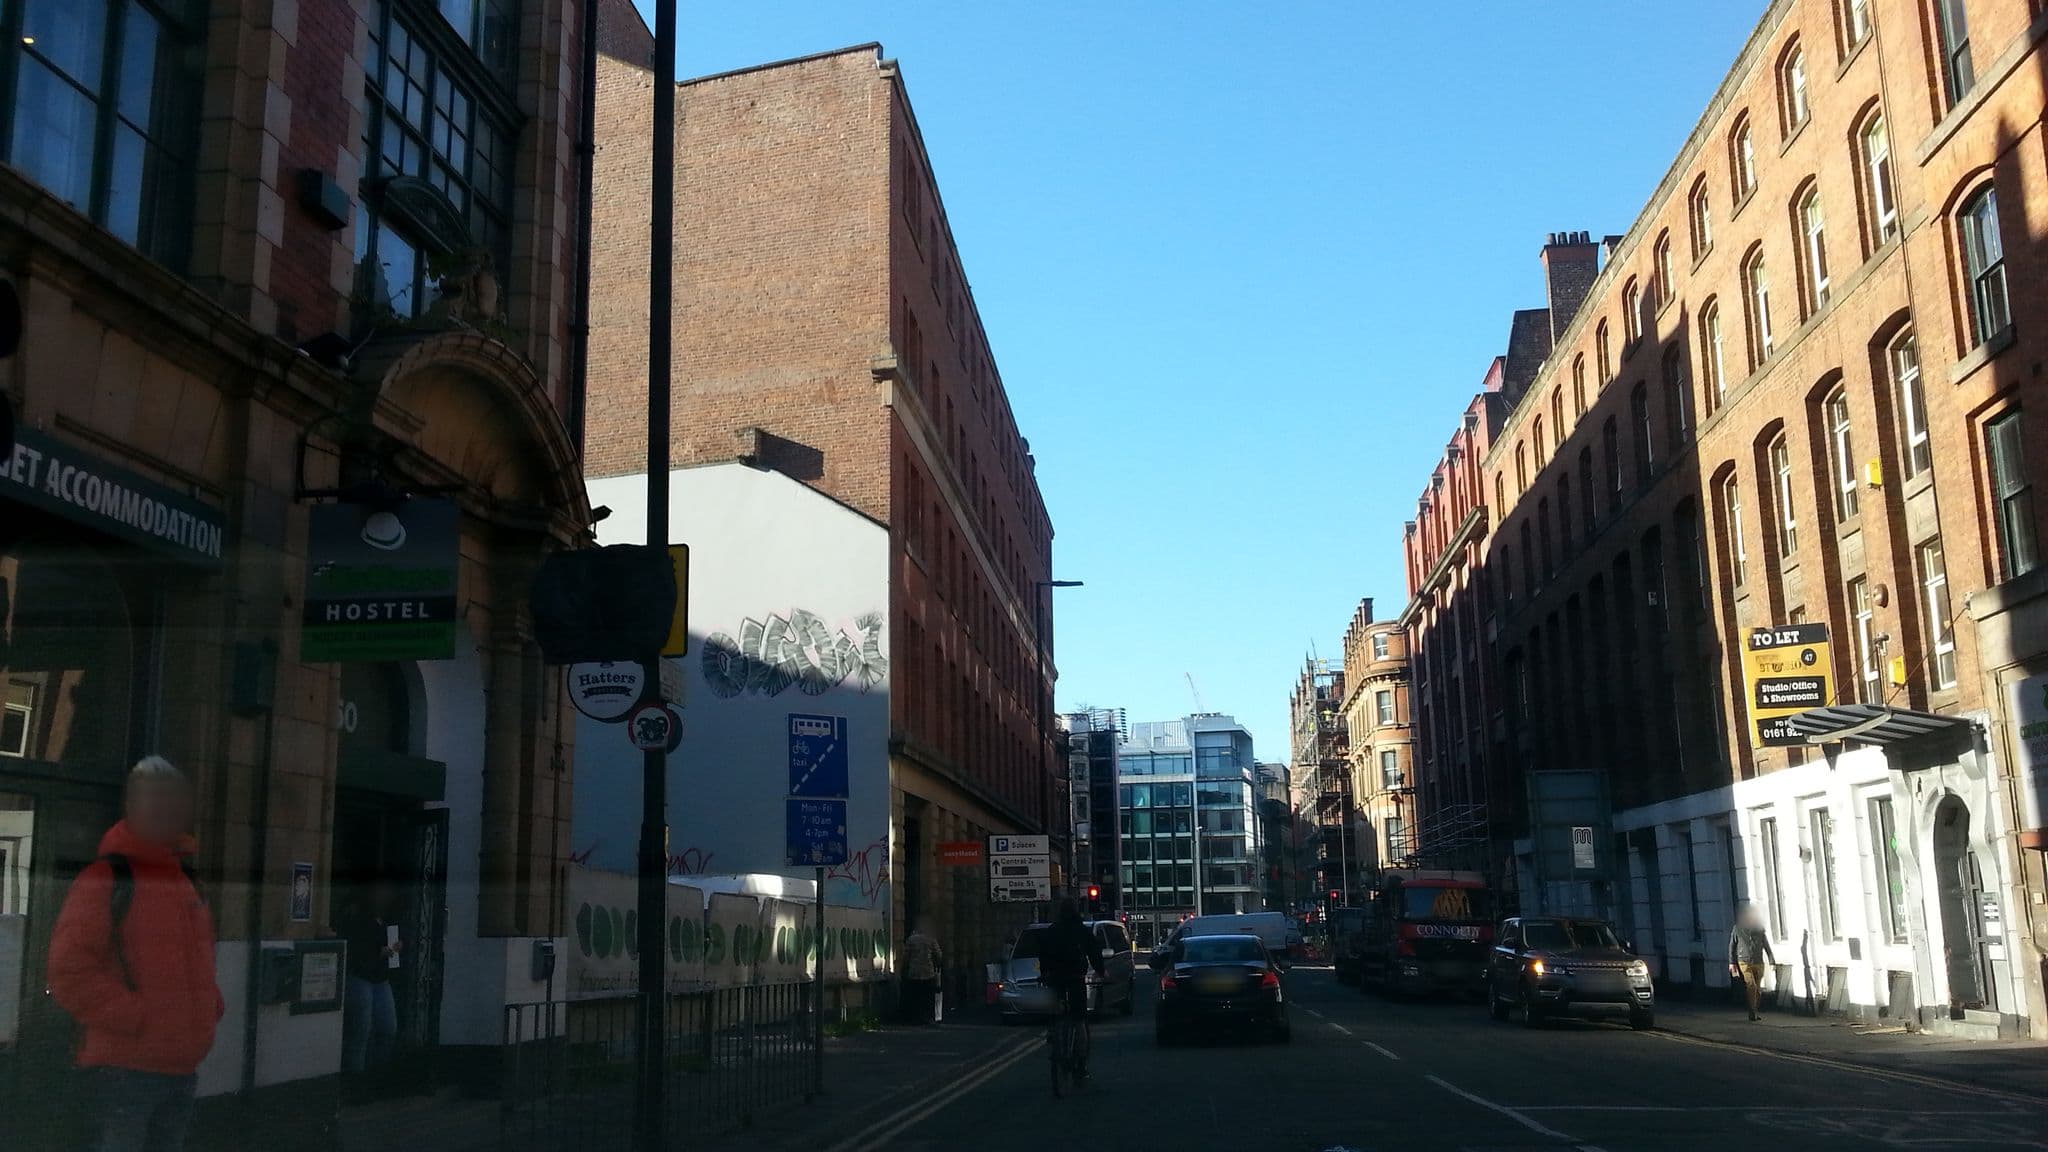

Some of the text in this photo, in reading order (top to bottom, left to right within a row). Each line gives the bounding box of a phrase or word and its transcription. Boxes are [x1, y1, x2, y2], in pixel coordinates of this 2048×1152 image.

[45, 457, 223, 558] ACCOMMODATION
[326, 601, 432, 621] HOSTEL
[1753, 631, 1800, 646] TO LET
[578, 671, 637, 687] Hatters
[1761, 682, 1818, 693] Studio/Office
[1770, 693, 1819, 703] Showrooms
[1763, 729, 1785, 739] 0161
